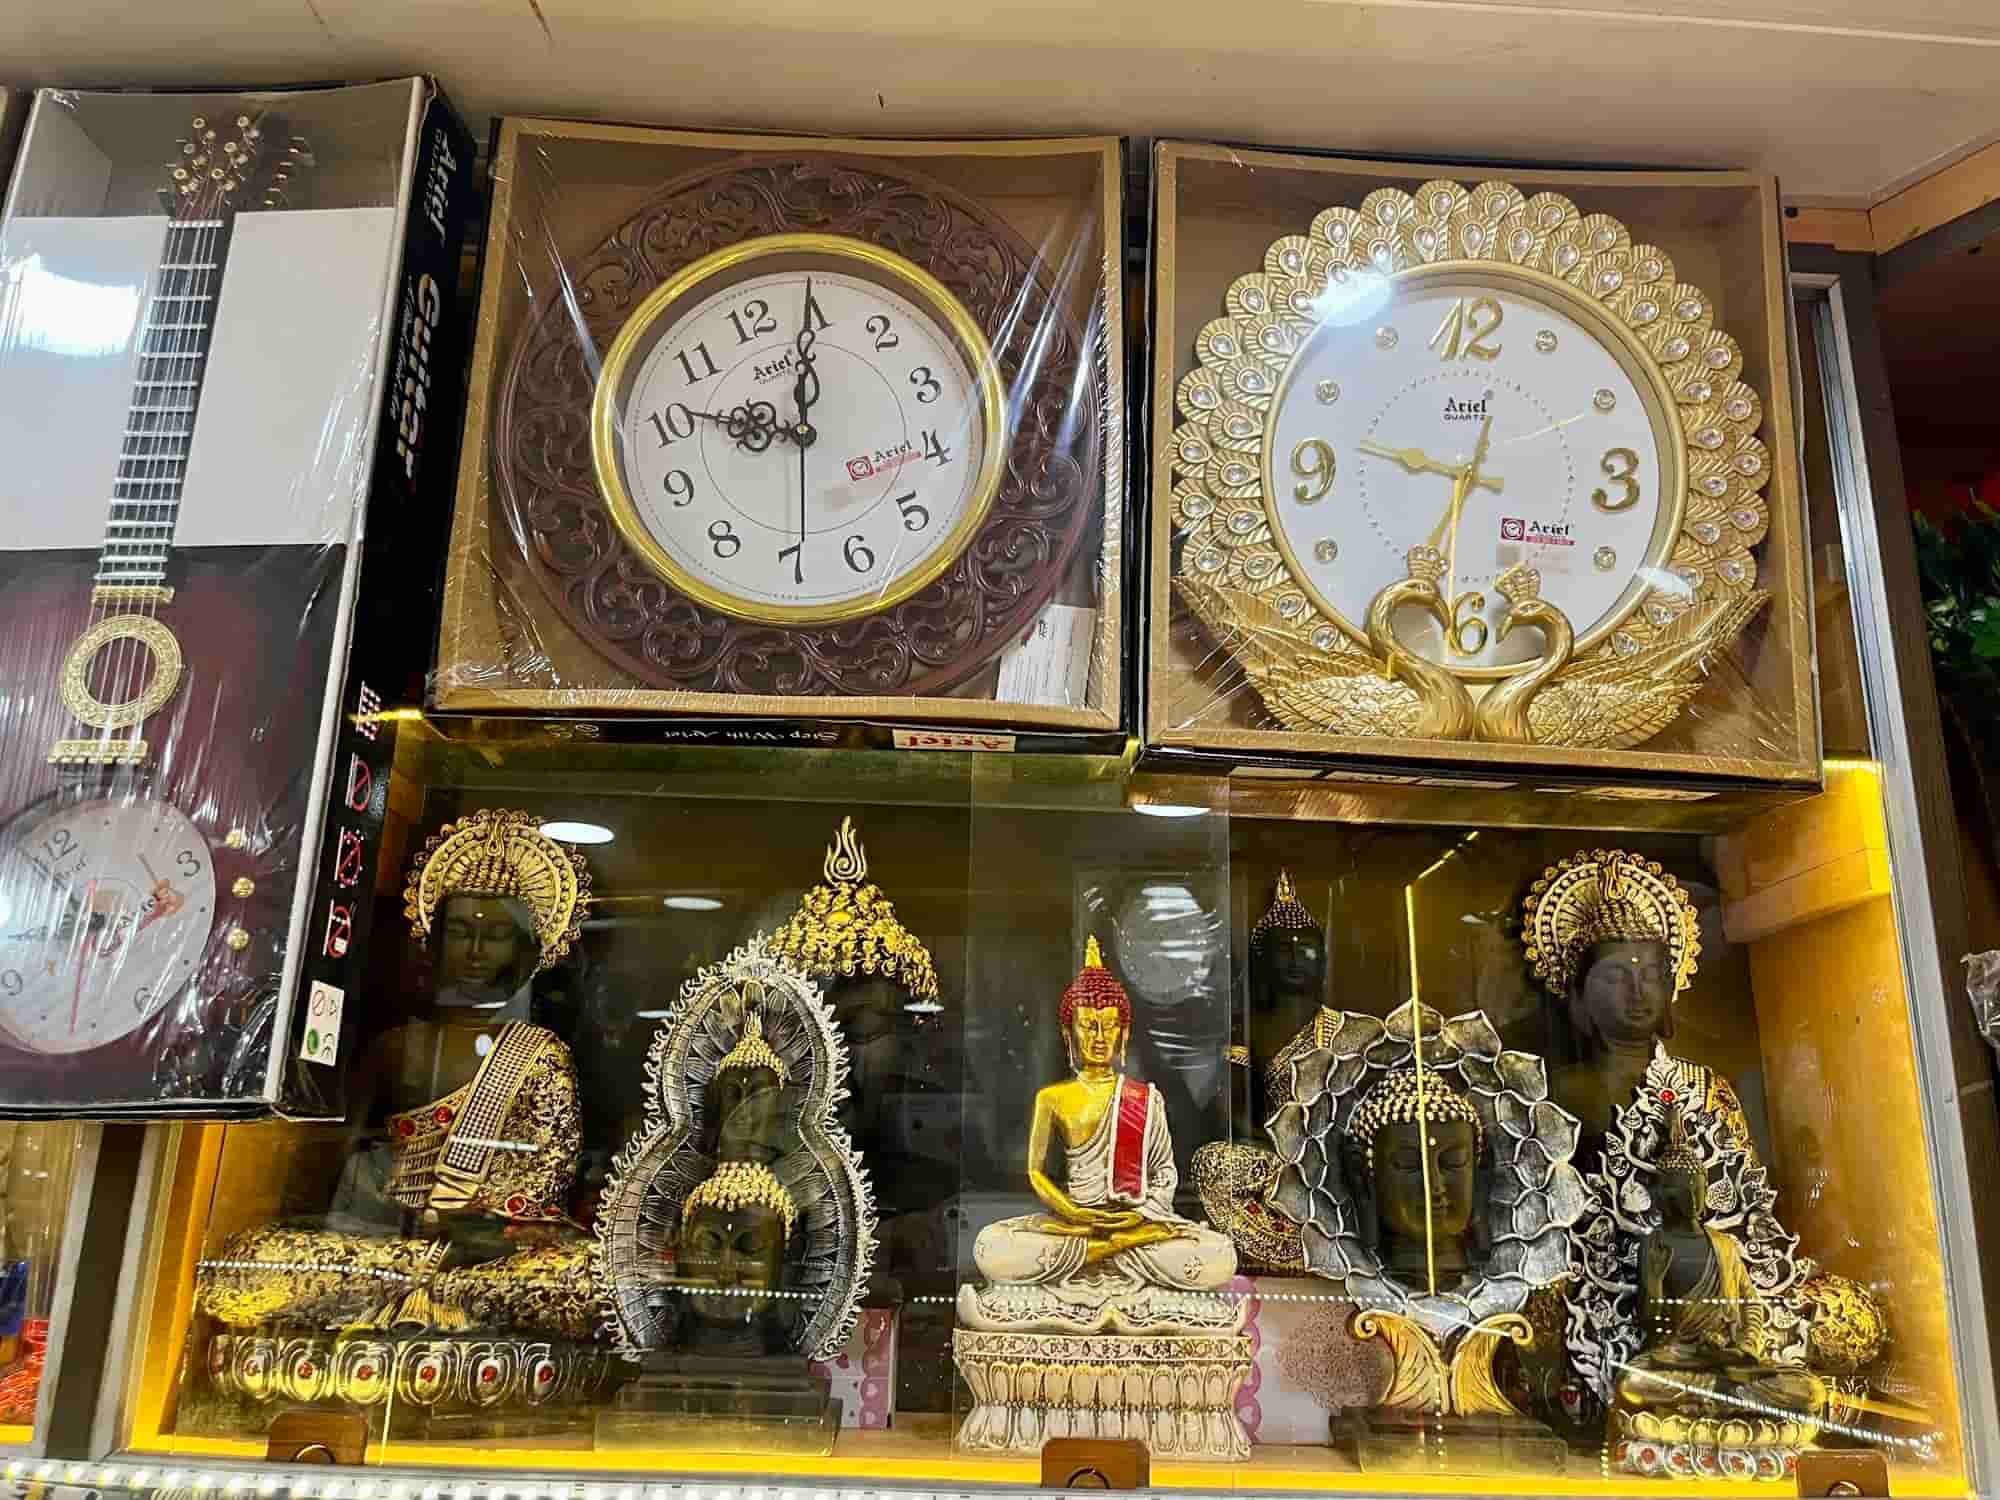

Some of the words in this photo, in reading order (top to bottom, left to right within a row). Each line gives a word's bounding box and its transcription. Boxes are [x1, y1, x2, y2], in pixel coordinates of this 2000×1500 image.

[430, 131, 456, 241] Ariel
[724, 299, 776, 345] 12
[866, 315, 899, 352] 2
[1429, 297, 1503, 361] 12
[397, 273, 440, 479] Guitar
[673, 342, 723, 386] 11
[753, 353, 792, 381] Ariel
[909, 367, 941, 403] 3
[1444, 396, 1487, 413] Ariel
[648, 403, 695, 448] 10
[873, 439, 912, 462] Ariel
[921, 429, 952, 467] 4
[664, 470, 695, 507] 9
[1291, 437, 1336, 503] 9
[1592, 447, 1640, 511] 3
[896, 490, 929, 531] 5
[1527, 520, 1569, 536] Ariel
[707, 520, 741, 558] 8
[843, 535, 875, 573] 6
[778, 541, 804, 584] 7
[1450, 591, 1488, 656] 6
[903, 733, 1009, 750] Ariel
[176, 850, 200, 877] 3
[1, 969, 23, 996] 9
